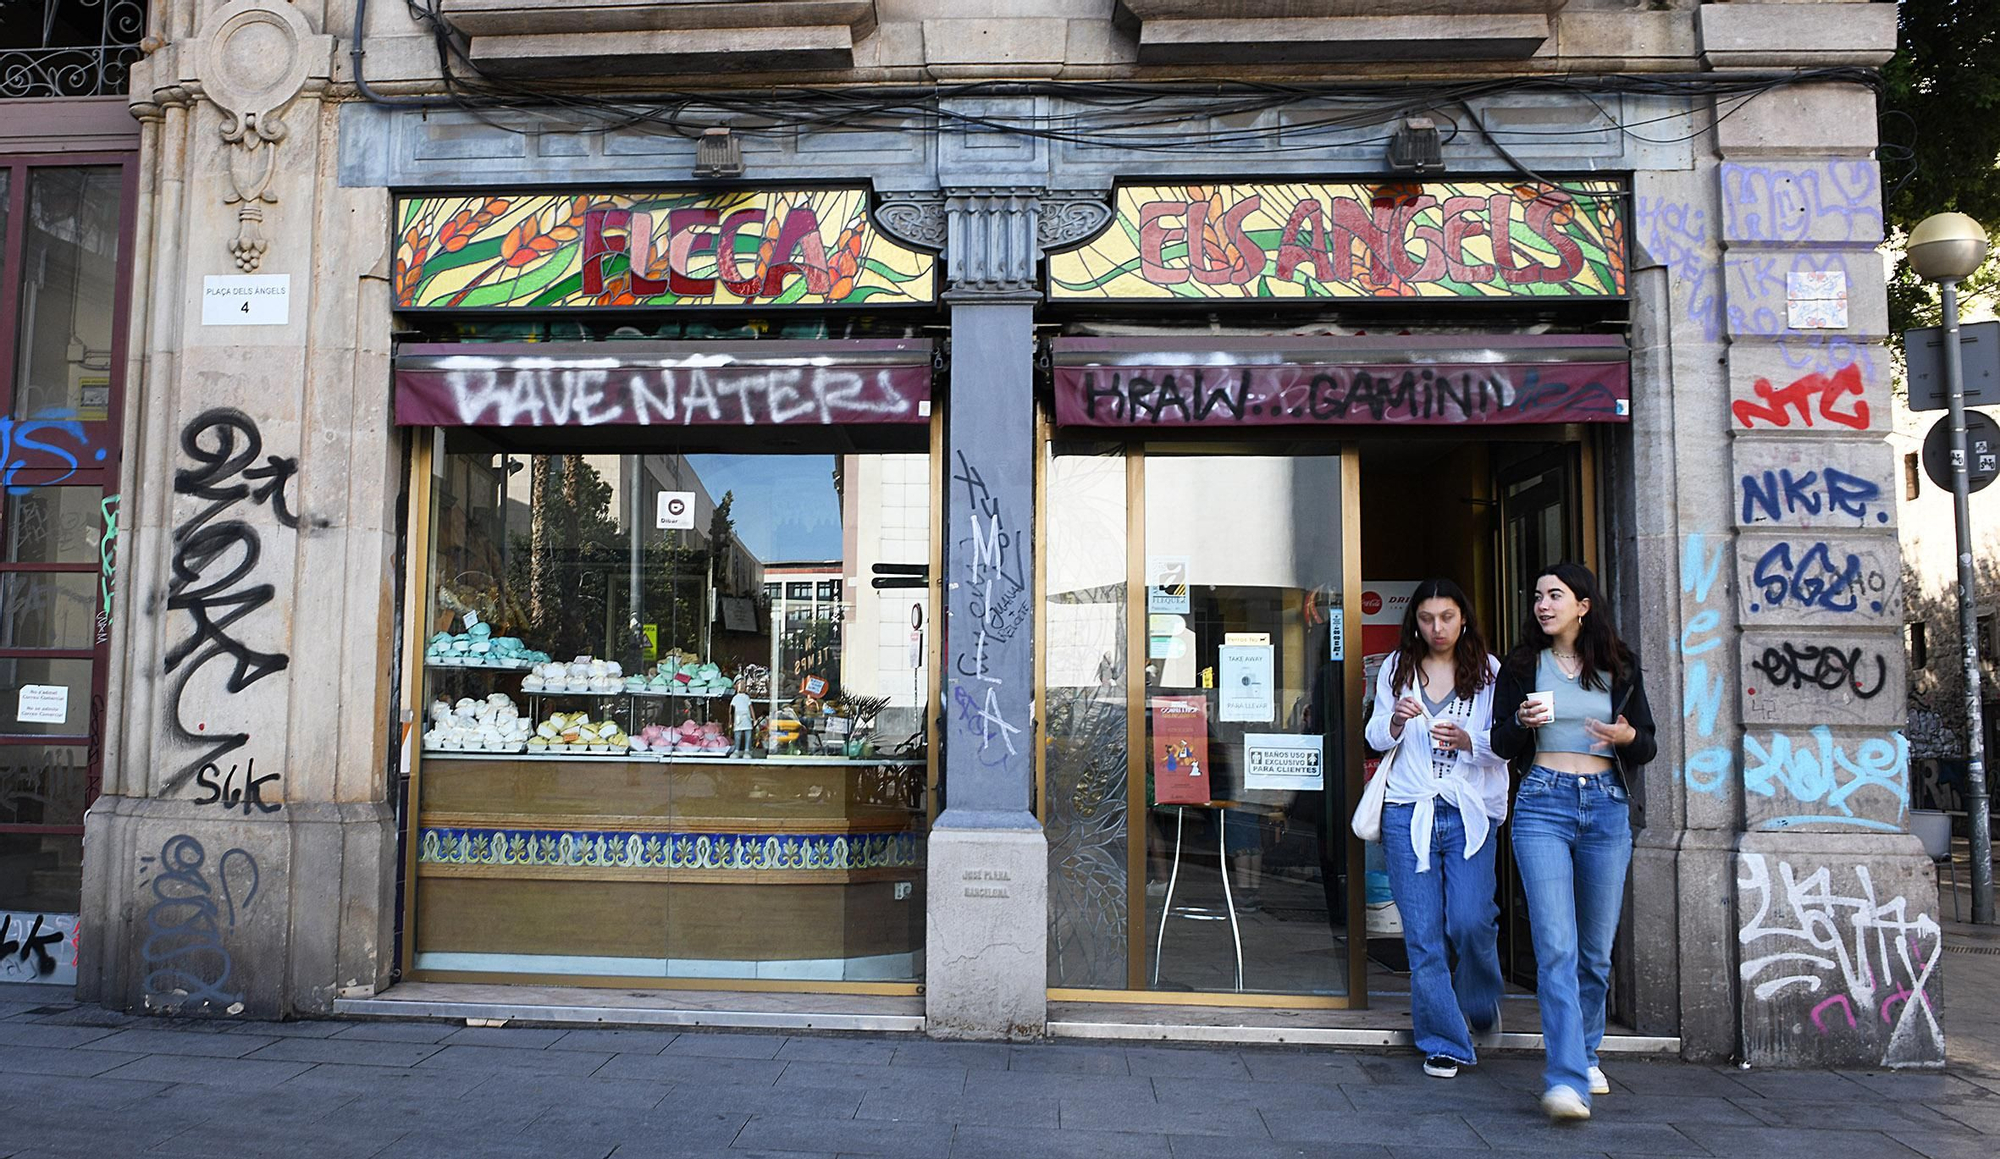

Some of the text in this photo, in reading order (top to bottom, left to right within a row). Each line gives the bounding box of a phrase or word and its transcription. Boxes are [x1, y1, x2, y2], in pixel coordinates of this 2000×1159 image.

[1139, 195, 1268, 286] ELS
[1275, 192, 1585, 285] ANGELS
[582, 207, 829, 296] FLECA
[206, 287, 231, 297] PLAÇA
[232, 287, 253, 295] DELS
[240, 300, 250, 314] 4
[1264, 750, 1289, 758] BAÑOS
